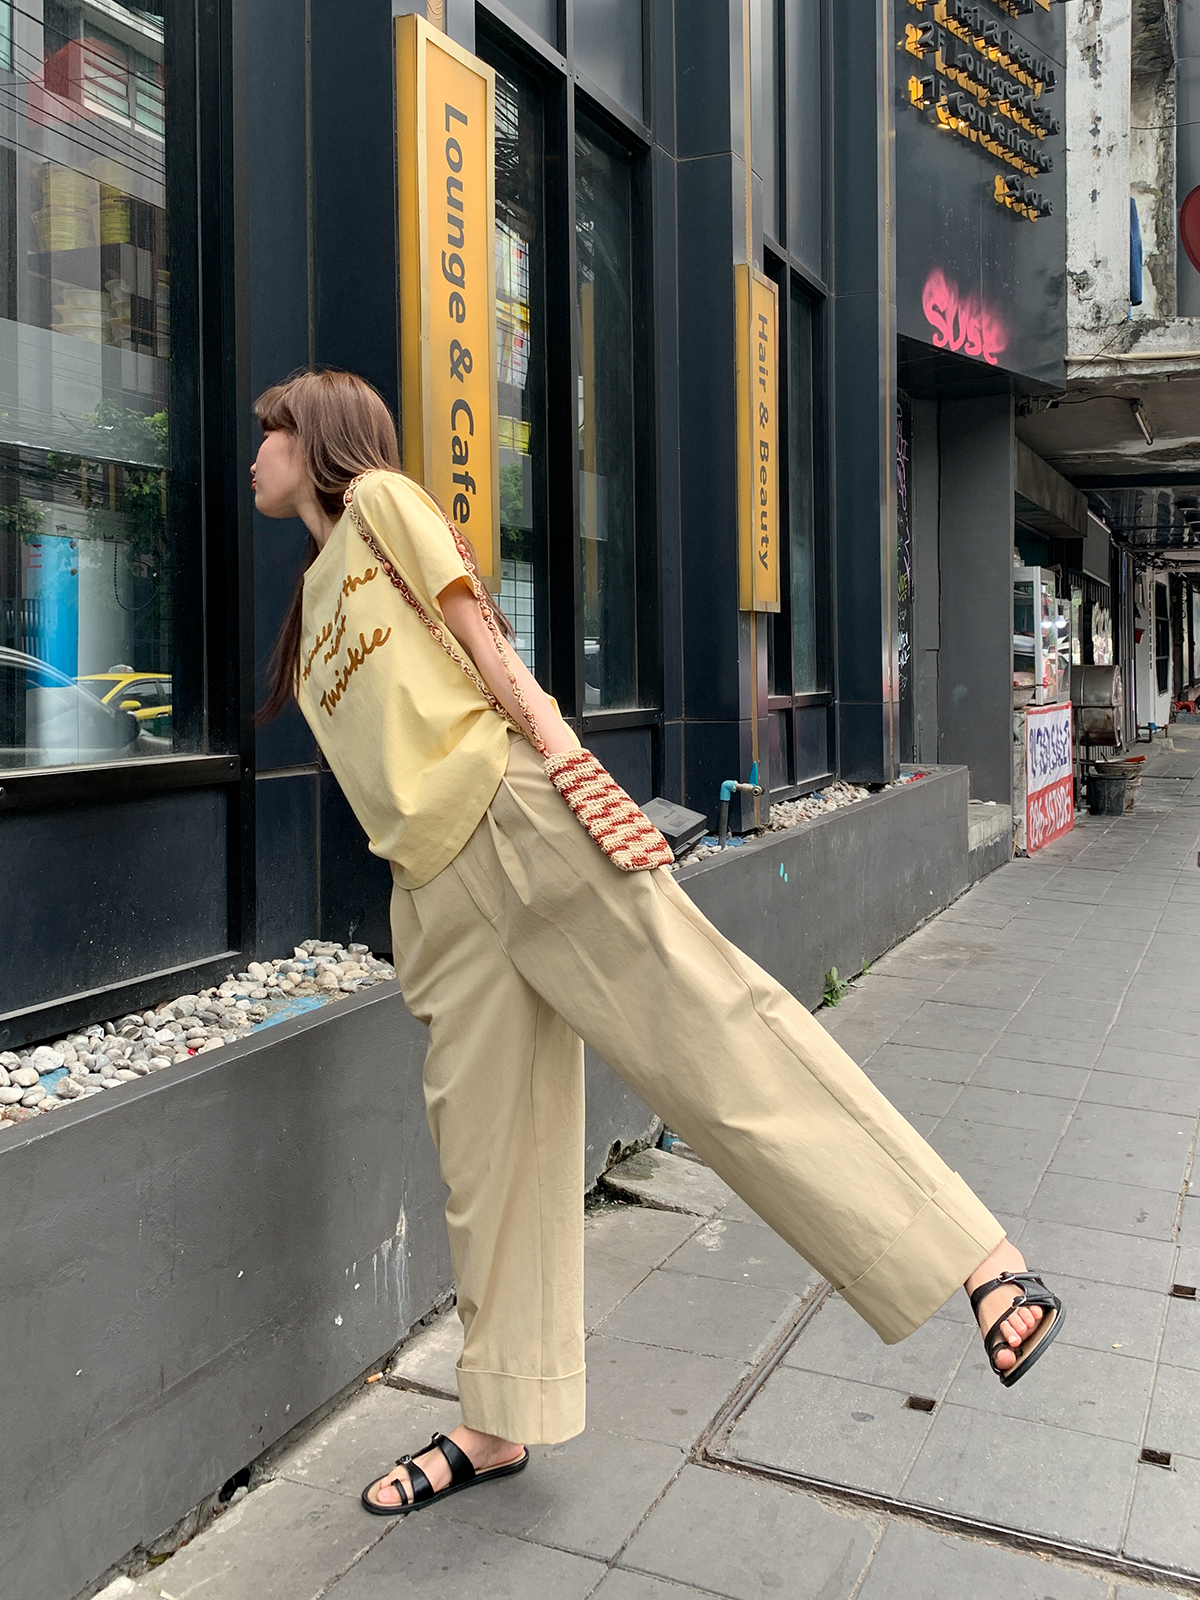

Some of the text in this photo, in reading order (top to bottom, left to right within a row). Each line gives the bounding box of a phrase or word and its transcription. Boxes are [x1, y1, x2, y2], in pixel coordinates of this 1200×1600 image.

[948, 41, 1018, 101] Lounge
[1003, 30, 1057, 94] Beauty
[949, 92, 1054, 174] Convenience
[1006, 174, 1054, 217] Store
[442, 102, 477, 525] Lounge & Cafe
[758, 312, 770, 571] Hair & Beauty
[342, 566, 378, 598] the
[319, 626, 391, 716] Twinkle
